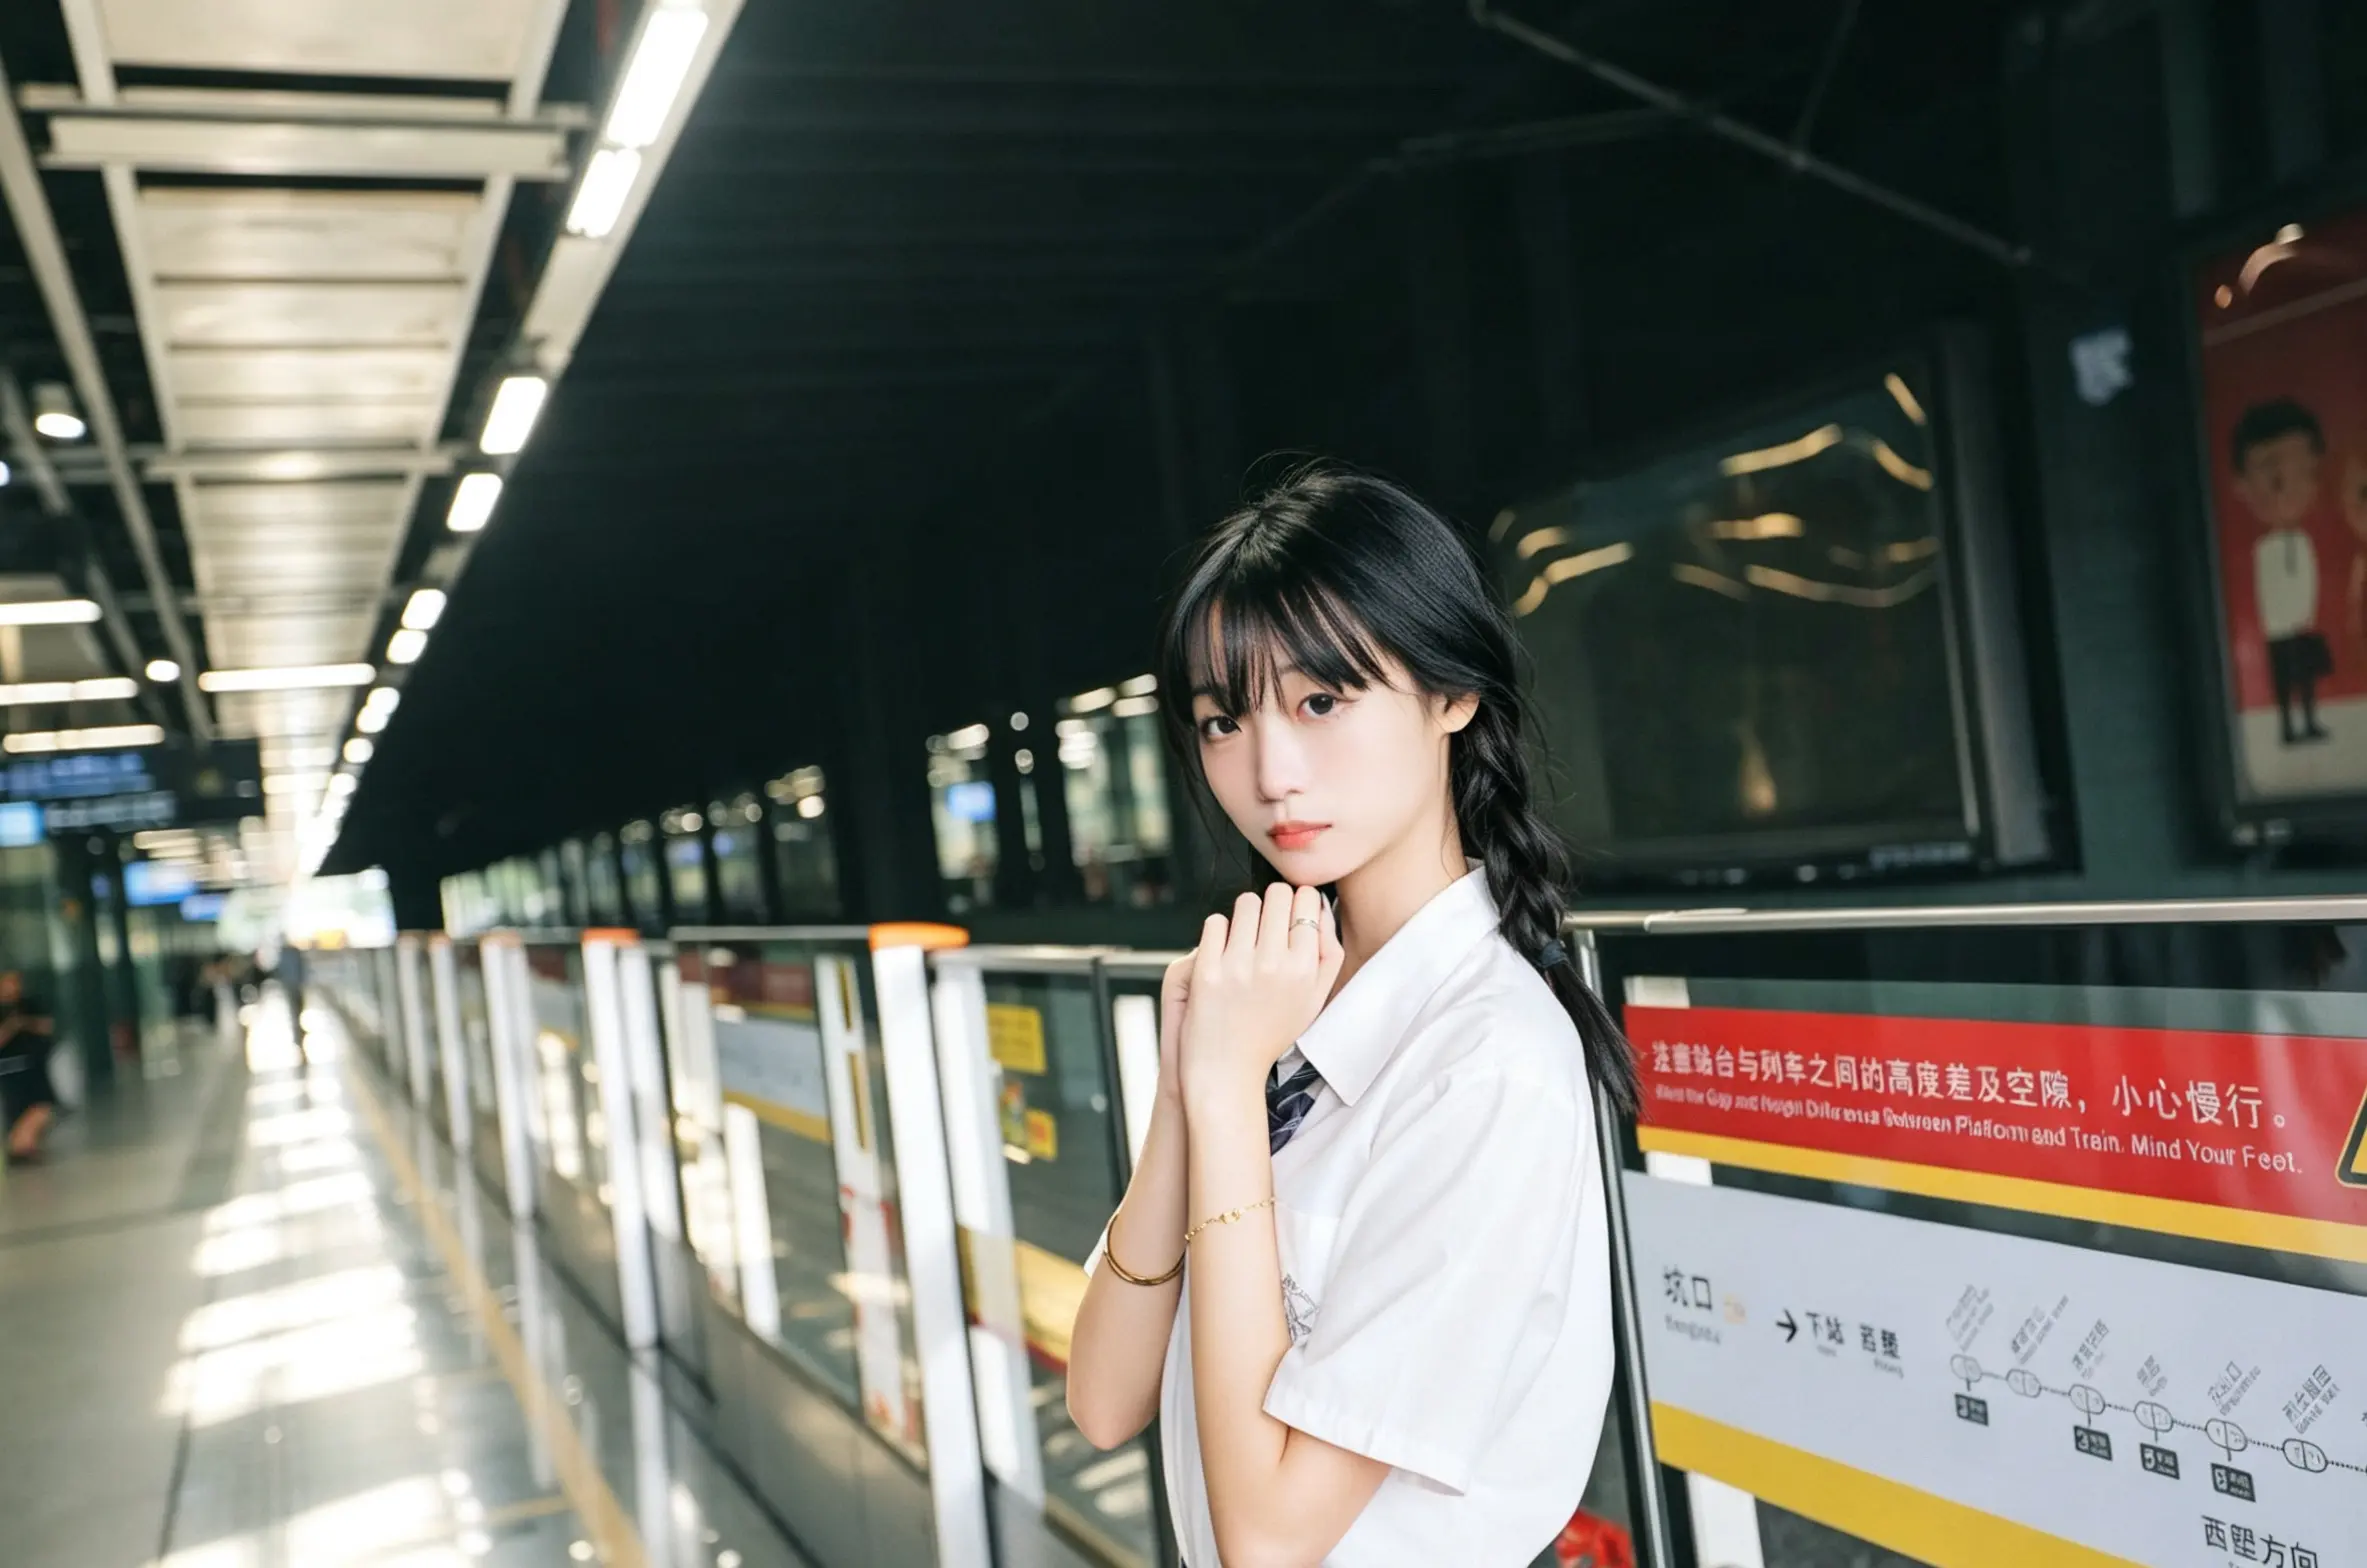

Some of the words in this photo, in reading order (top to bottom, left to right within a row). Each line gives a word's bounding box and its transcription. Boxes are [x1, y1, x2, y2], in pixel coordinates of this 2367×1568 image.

[2031, 1126, 2066, 1147] and
[2131, 1133, 2181, 1160] Mind
[2186, 1139, 2236, 1166] Your
